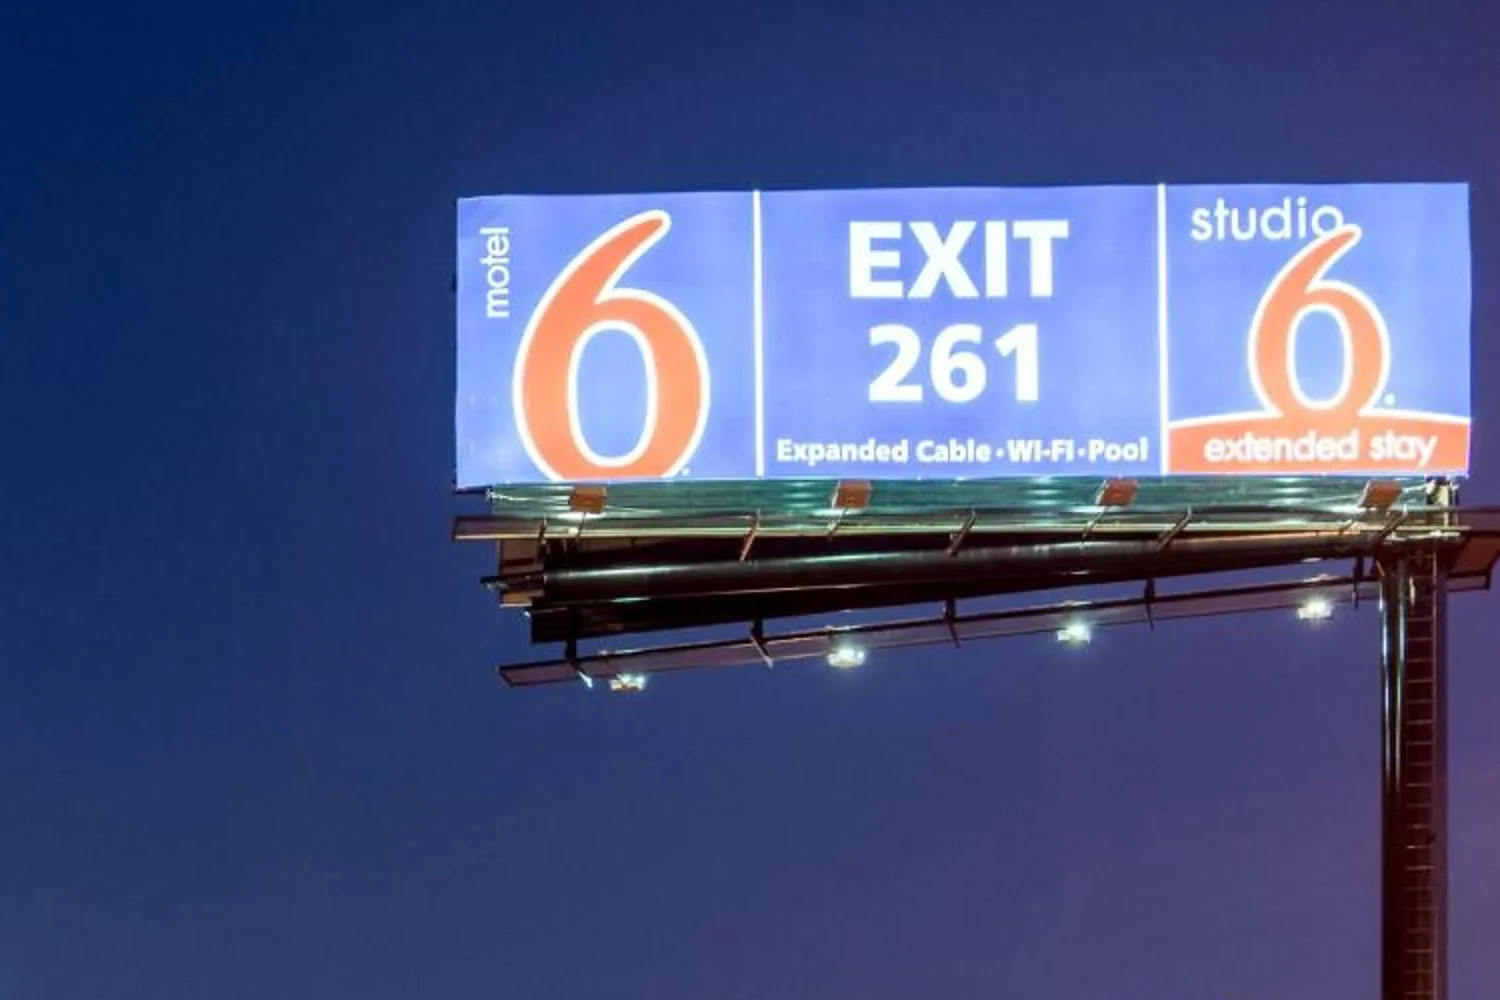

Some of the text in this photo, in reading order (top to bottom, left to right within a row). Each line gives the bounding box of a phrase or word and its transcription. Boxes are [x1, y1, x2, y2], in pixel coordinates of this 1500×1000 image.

[848, 219, 1070, 300] EXIT
[479, 208, 711, 484] motel 6
[1190, 196, 1392, 418] studio 6
[867, 323, 1040, 404] 261
[776, 438, 909, 466] Expanded
[916, 438, 992, 463] Cable
[1087, 436, 1150, 462] Pool
[1203, 427, 1439, 468] extended stay
